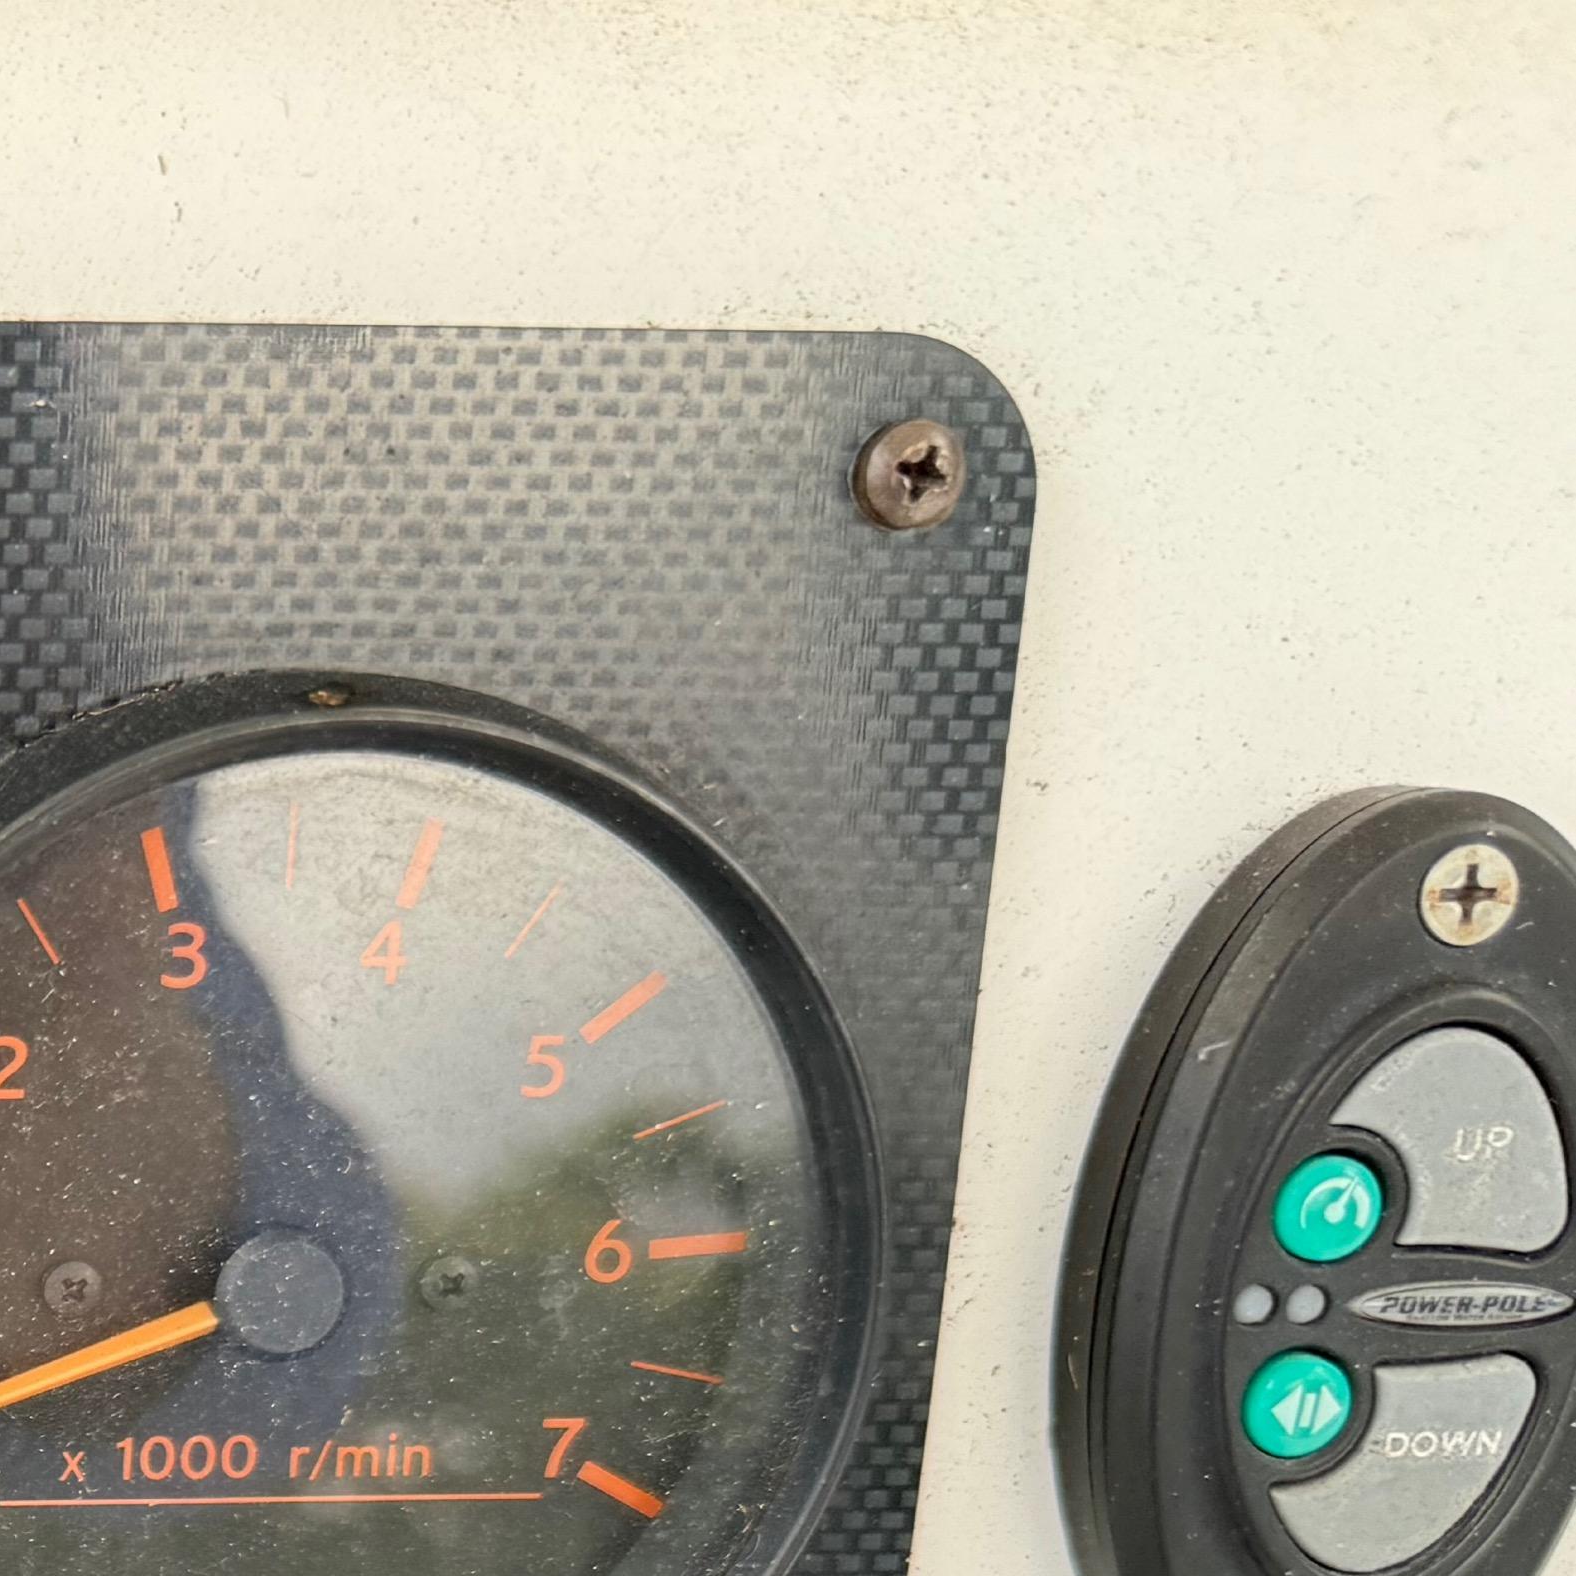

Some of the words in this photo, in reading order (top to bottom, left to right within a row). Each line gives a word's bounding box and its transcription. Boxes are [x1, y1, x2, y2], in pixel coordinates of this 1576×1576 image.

[160, 923, 208, 990] 3
[360, 920, 408, 985] 4
[520, 1035, 567, 1098] 5
[1452, 1126, 1515, 1162] UP
[585, 1218, 633, 1283] 6
[1379, 1294, 1547, 1314] POWER-POLE
[114, 1434, 259, 1482] 1000
[287, 1432, 432, 1481] r/min
[542, 1417, 587, 1479] 7
[1384, 1430, 1503, 1458] DOWN
